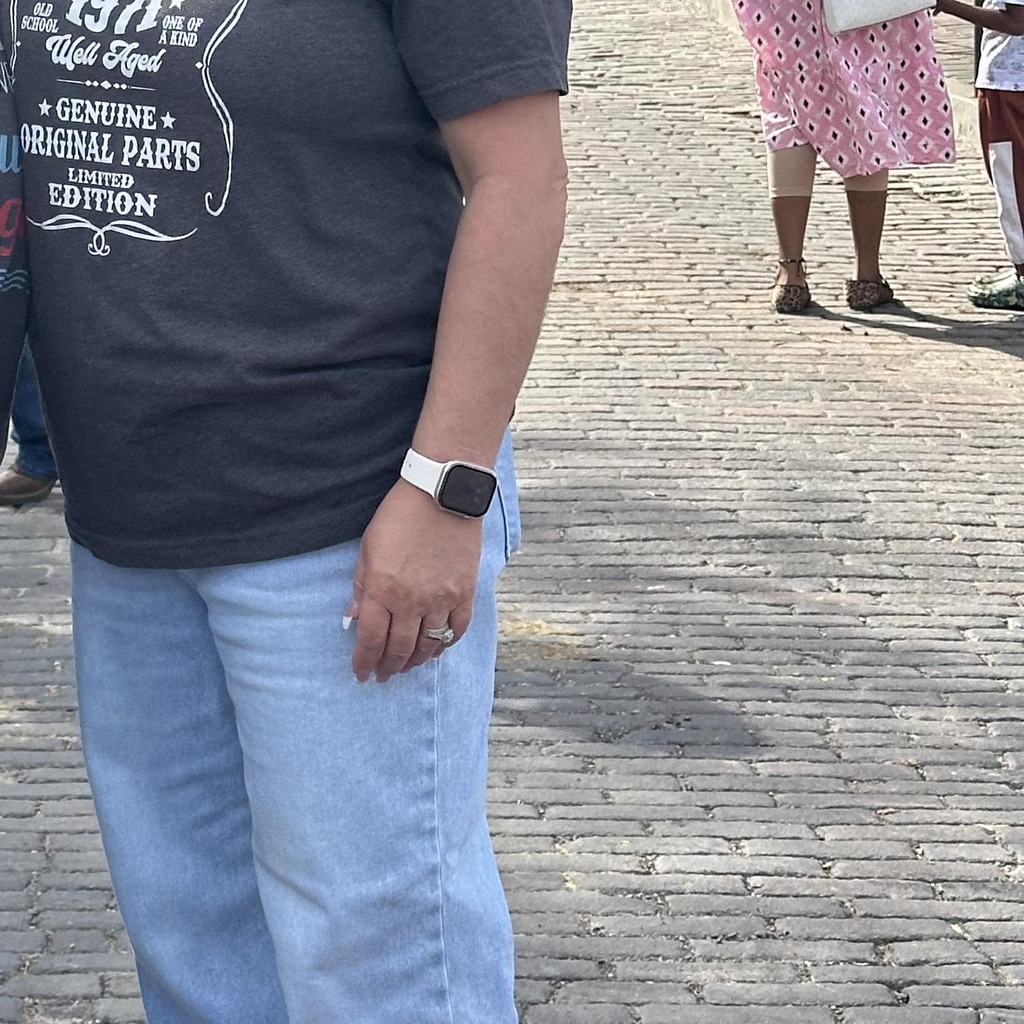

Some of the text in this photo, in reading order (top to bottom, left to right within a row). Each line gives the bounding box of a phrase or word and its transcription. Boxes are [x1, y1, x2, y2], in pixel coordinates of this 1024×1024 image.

[33, 2, 54, 17] OLD
[21, 15, 59, 33] SCHOOL
[162, 15, 204, 32] ONE OF
[158, 31, 198, 47] A KIND
[45, 33, 166, 78] Well Aged
[55, 97, 157, 130] GENUINE
[20, 123, 201, 172] ORIGINAL PARTS
[68, 167, 135, 189] LIMITED
[48, 183, 158, 217] EDITION
